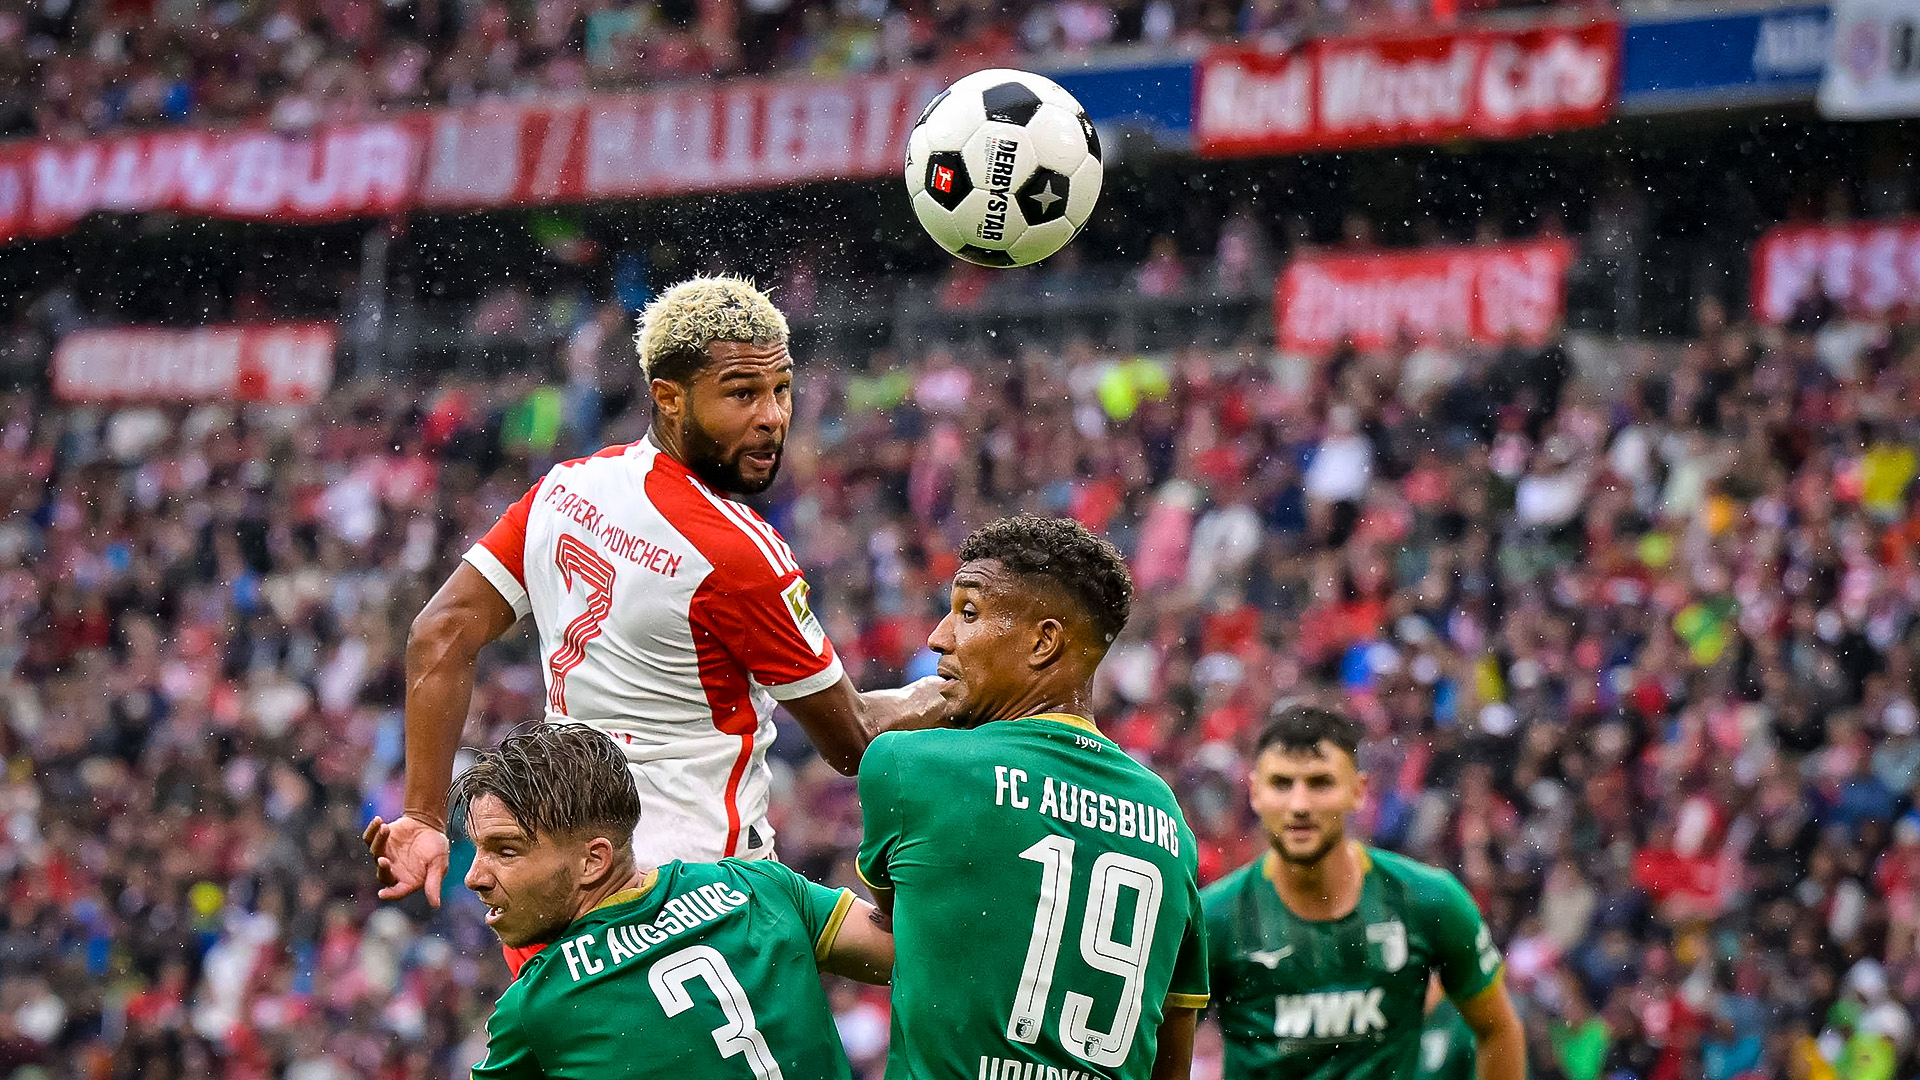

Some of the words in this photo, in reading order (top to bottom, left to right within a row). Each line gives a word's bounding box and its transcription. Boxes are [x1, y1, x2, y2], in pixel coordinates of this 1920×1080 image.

[982, 139, 1018, 241] DERBYSTAR
[600, 521, 683, 578] MÜNCHEN
[549, 533, 617, 716] 7
[1074, 734, 1102, 753] 1907
[994, 765, 1030, 810] FC
[1039, 776, 1180, 858] AUGSBURG
[561, 933, 604, 982] FC
[606, 881, 749, 965] AUGSBURG
[1006, 834, 1164, 1068] 19
[1273, 986, 1388, 1039] WWK
